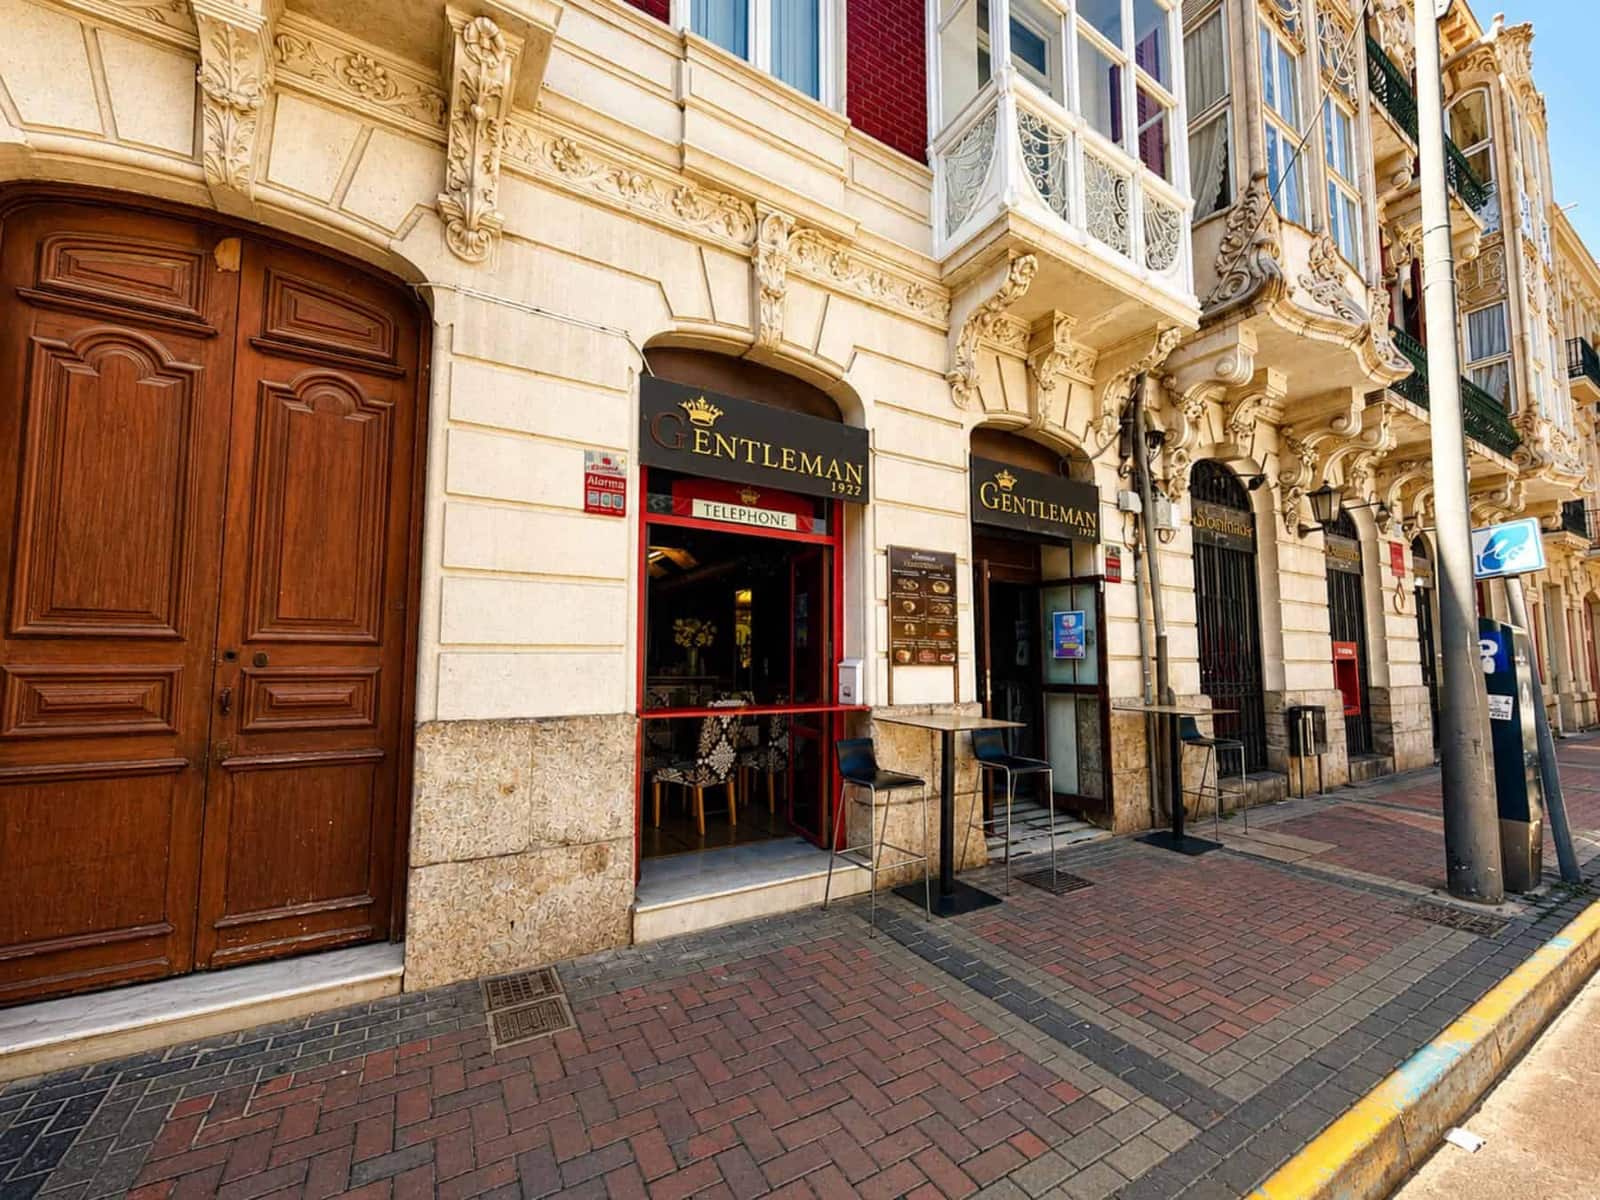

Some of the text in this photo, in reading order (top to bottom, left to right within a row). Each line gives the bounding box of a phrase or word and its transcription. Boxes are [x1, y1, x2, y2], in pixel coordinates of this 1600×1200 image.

[650, 411, 864, 485] GENTLEMAN
[587, 475, 625, 490] Alarma
[831, 481, 862, 496] 1922
[703, 503, 788, 527] TELEPHONE
[980, 481, 1096, 528] GENTLEMAN
